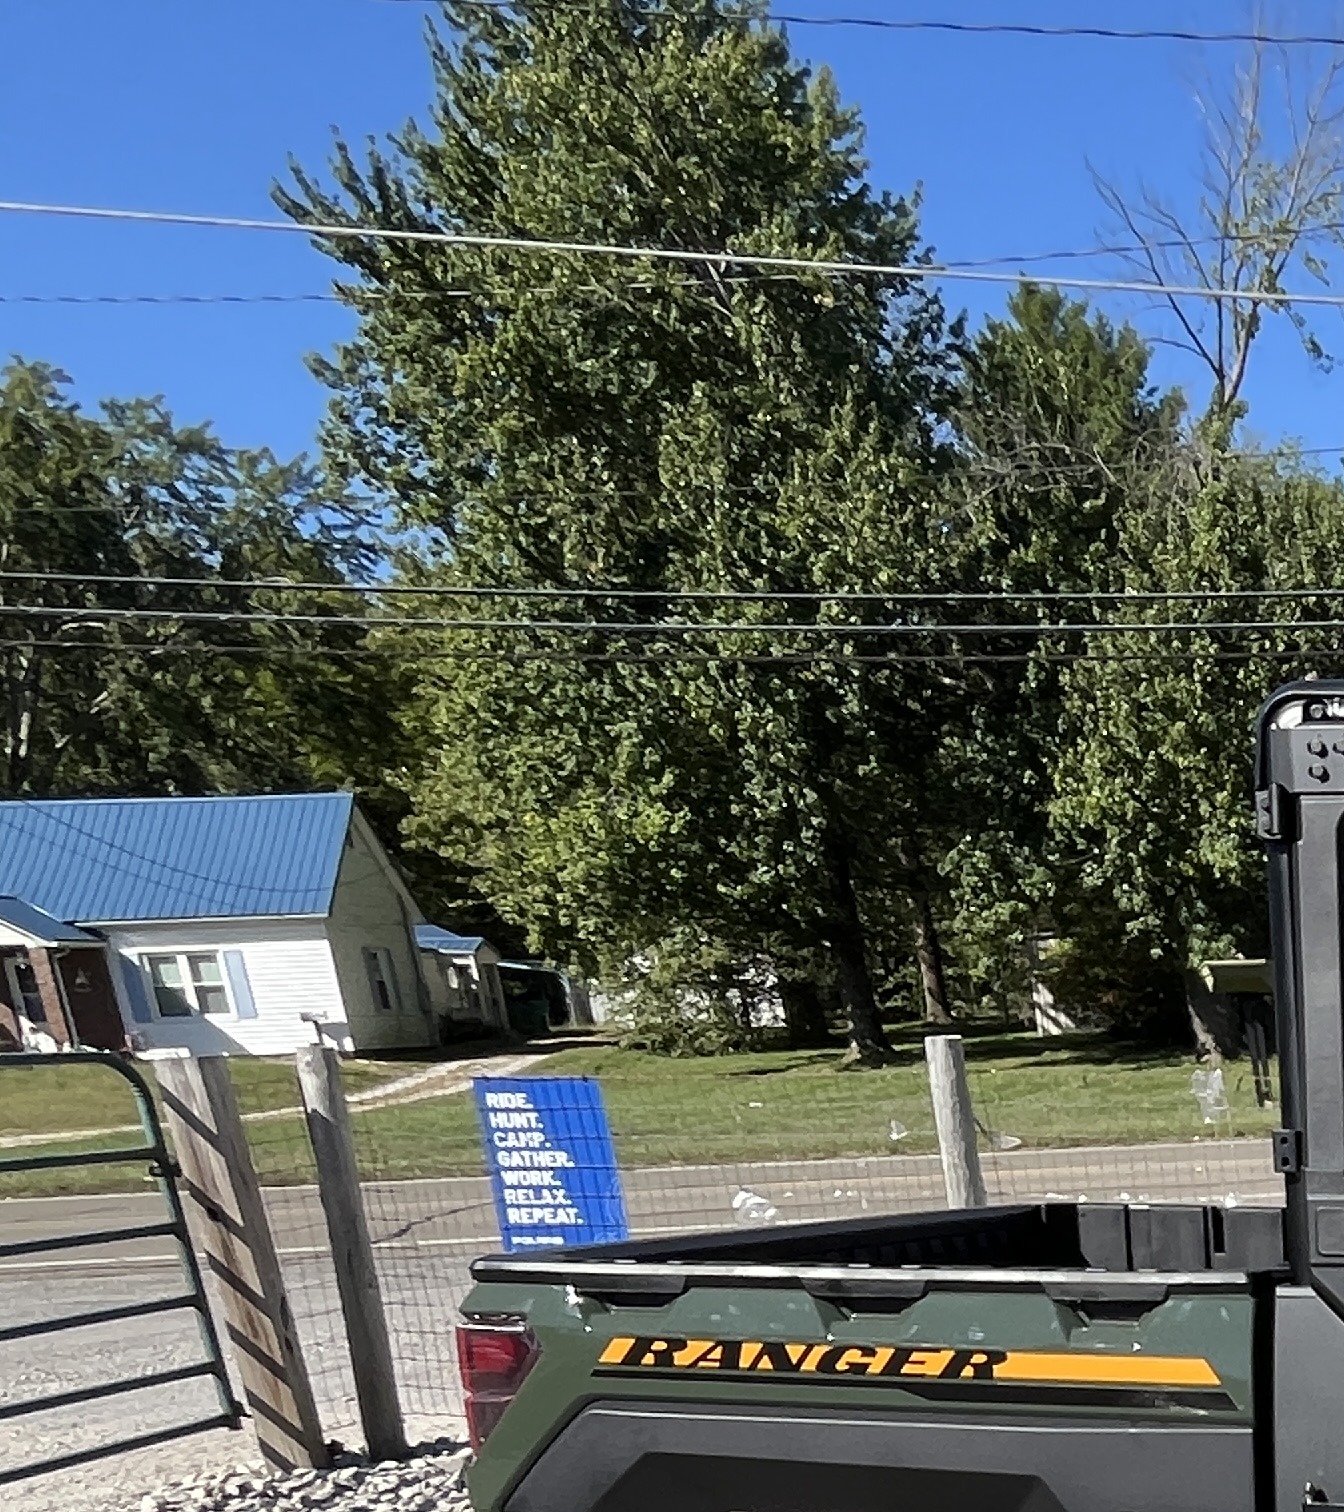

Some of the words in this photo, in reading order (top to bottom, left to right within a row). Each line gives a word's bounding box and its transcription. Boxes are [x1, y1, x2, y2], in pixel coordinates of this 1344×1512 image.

[485, 1092, 534, 1109] RIDE.
[489, 1111, 544, 1129] HUNT.
[493, 1131, 552, 1148] CAMP.
[497, 1150, 576, 1168] GATHER.
[501, 1170, 562, 1186] WORK.
[503, 1188, 572, 1205] RELAX.
[507, 1207, 584, 1225] REPEAT.
[622, 1336, 1008, 1380] RANGER
